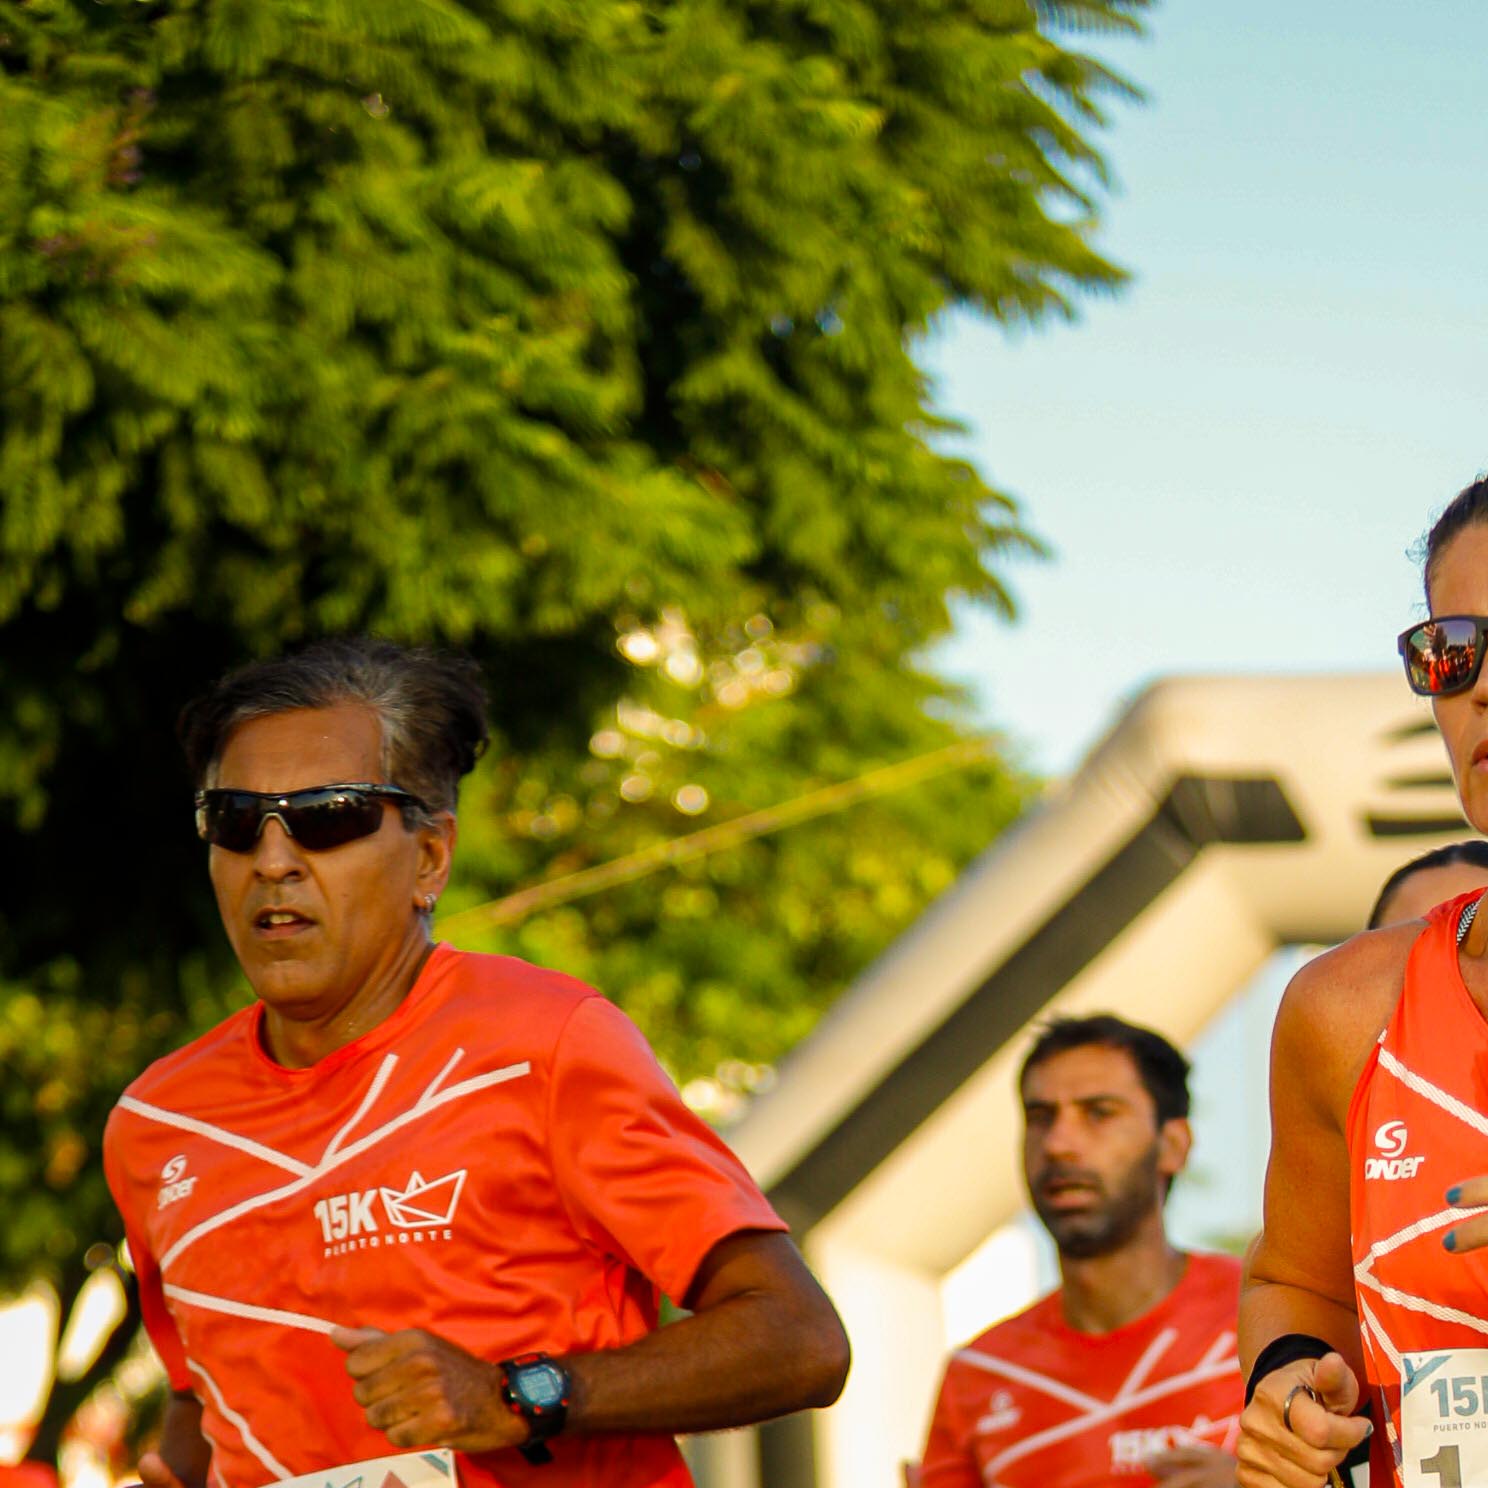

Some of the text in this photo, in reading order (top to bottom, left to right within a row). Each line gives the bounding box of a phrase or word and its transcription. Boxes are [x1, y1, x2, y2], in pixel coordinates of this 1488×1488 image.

[313, 1188, 379, 1243] 15K
[385, 1229, 453, 1246] NORTE
[1433, 1422, 1471, 1432] PUERTO
